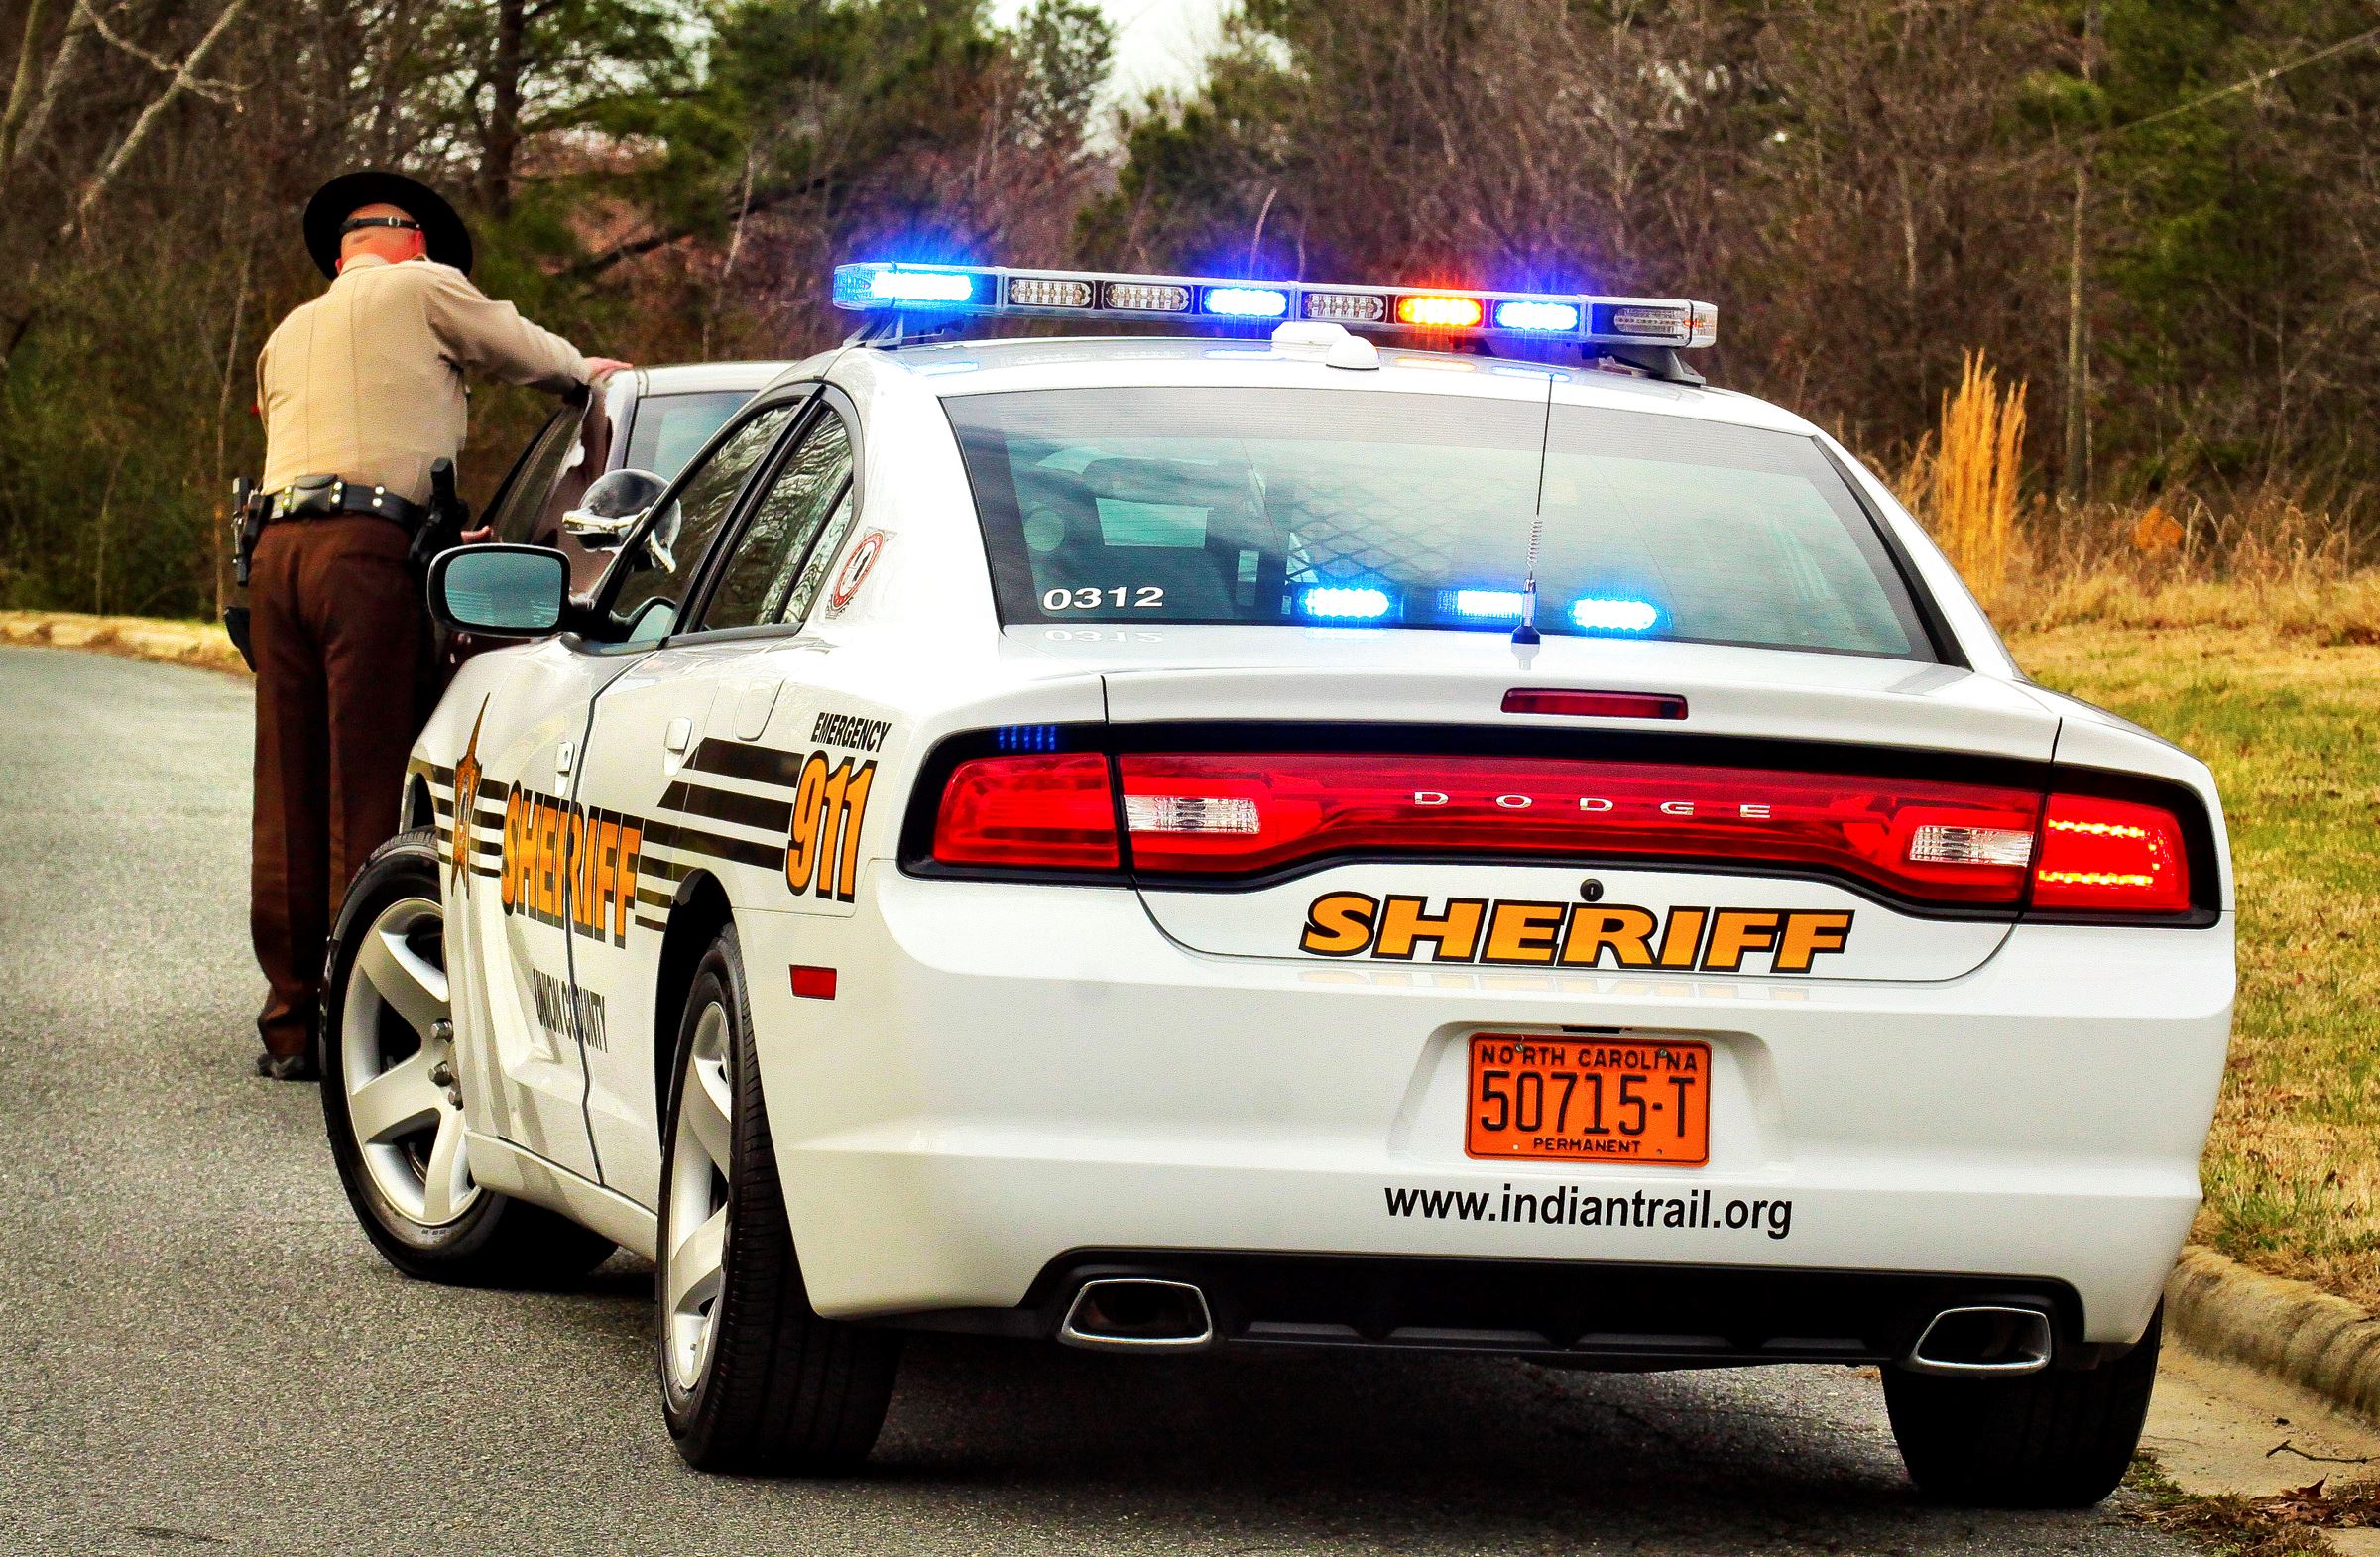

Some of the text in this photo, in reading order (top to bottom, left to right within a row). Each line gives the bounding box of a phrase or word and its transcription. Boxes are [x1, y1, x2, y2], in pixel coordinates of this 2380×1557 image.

[1043, 586, 1164, 611] 0312
[810, 712, 892, 753] EMERGENCY
[785, 749, 878, 903] 911
[1414, 790, 1772, 818] DODGE
[501, 780, 645, 949] SHERIFF
[1299, 891, 1855, 974] SHERIFF
[533, 968, 564, 1036] UNION
[1481, 1045, 1698, 1072] NORTH CAROLINA
[1481, 1070, 1696, 1138] 50715-T
[1533, 1138, 1642, 1153] PERMANENT
[1384, 1183, 1793, 1240] www.indiantrail.org
